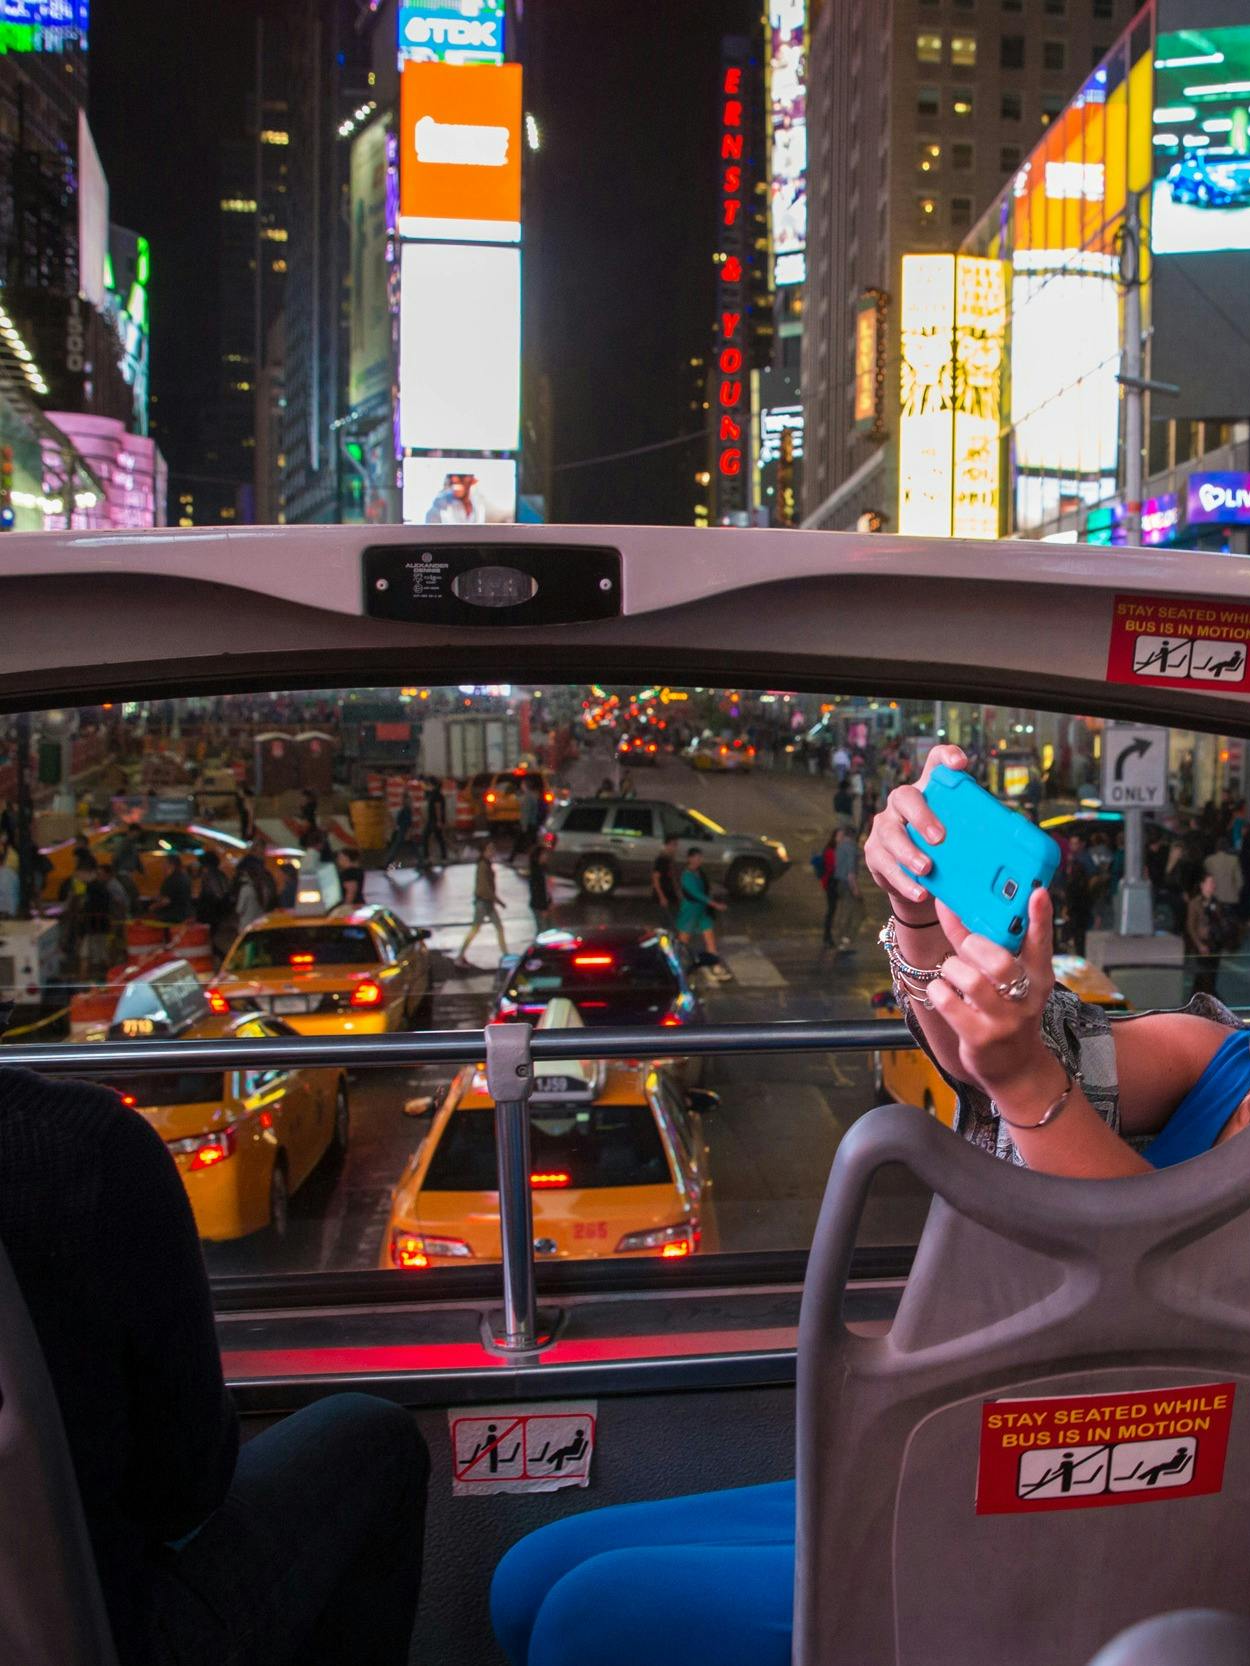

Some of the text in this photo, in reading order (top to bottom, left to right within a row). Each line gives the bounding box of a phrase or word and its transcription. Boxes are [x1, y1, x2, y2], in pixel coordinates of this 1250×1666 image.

[424, 18, 497, 47] TDK
[720, 67, 743, 475] ERNST & YOUNG
[1117, 603, 1156, 617] STAY
[1158, 607, 1216, 622] SEATED
[1125, 620, 1157, 634] BUS
[1160, 622, 1174, 635] IS
[1178, 623, 1194, 636] IN
[1112, 786, 1157, 802] ONLY
[987, 1395, 1229, 1429] STAY SEATED WHILE
[1002, 1416, 1211, 1448] BUS IS IN MOTION
